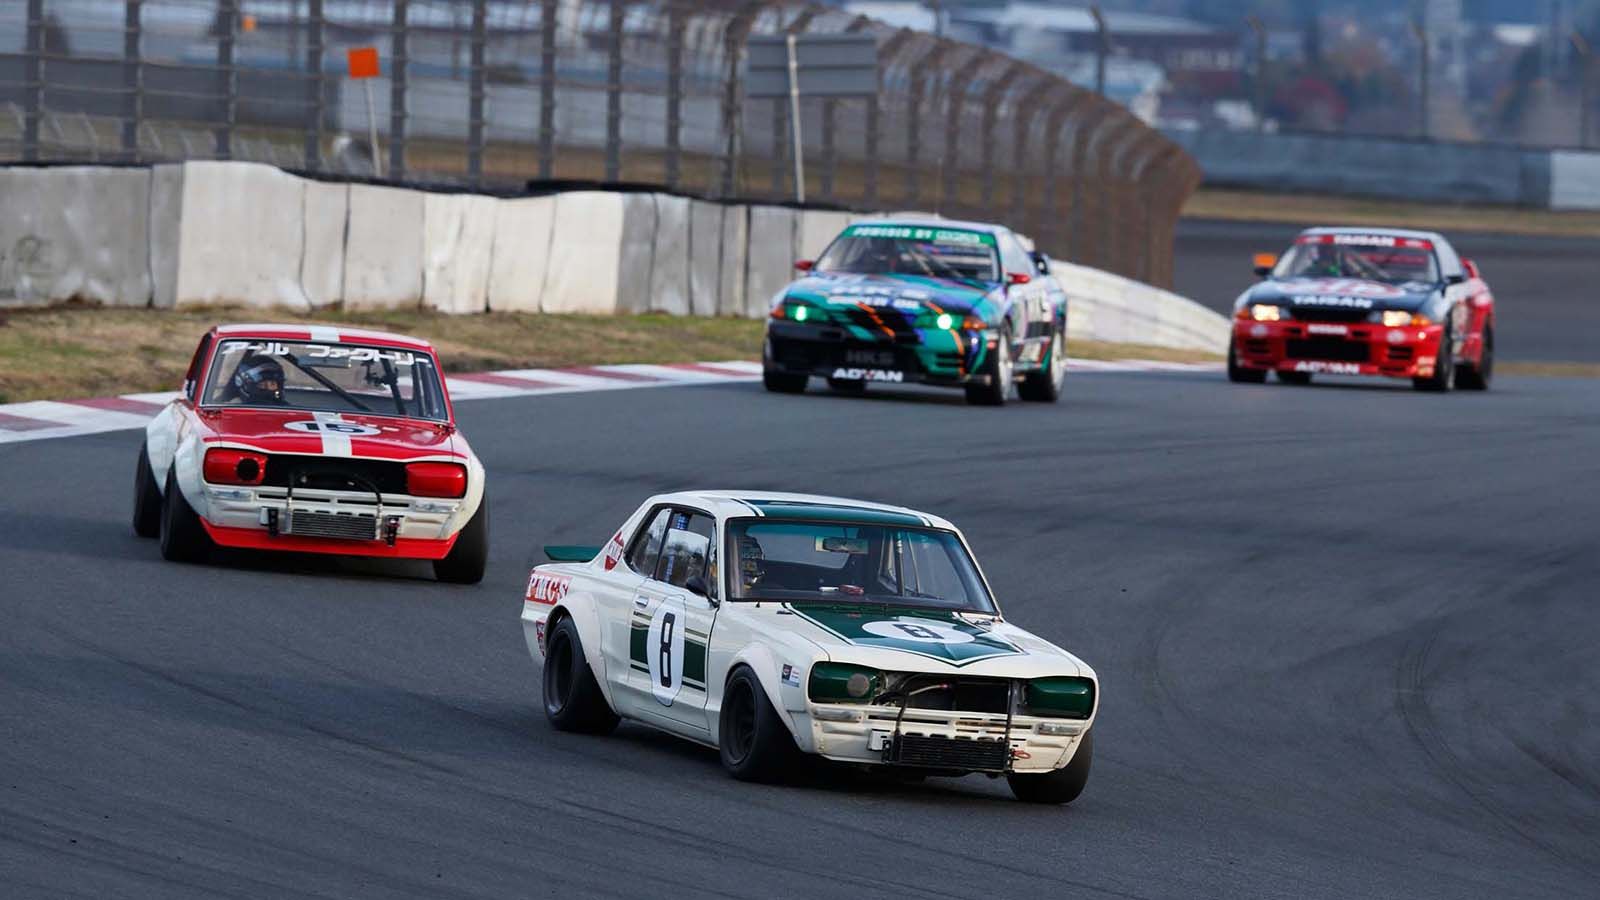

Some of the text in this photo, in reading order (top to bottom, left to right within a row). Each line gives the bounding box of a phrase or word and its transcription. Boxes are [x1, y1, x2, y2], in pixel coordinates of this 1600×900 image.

[1294, 295, 1373, 309] TAISAN
[832, 367, 904, 382] ADVAN
[892, 623, 945, 640] 8
[659, 611, 676, 689] 8
